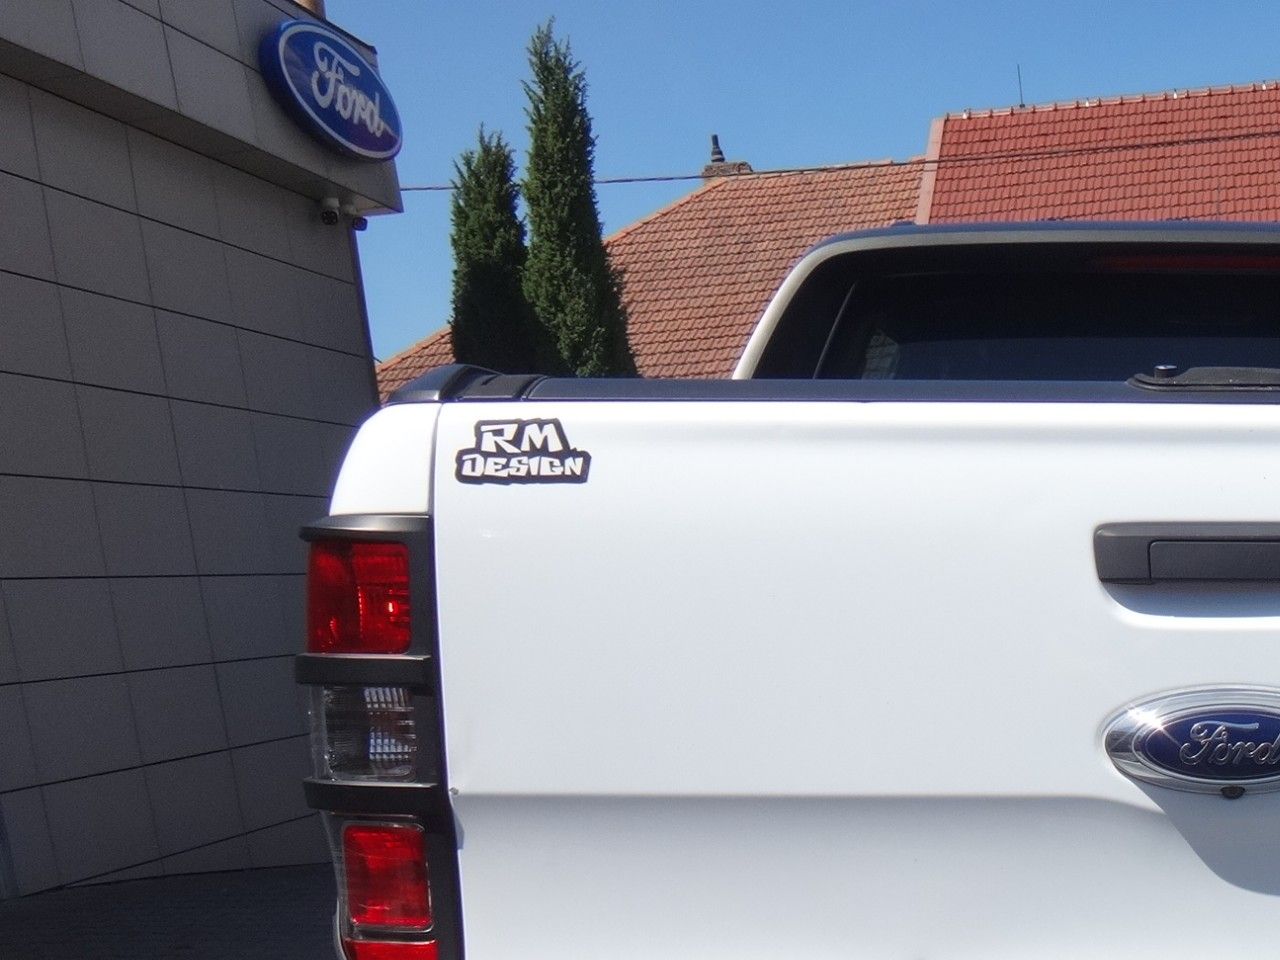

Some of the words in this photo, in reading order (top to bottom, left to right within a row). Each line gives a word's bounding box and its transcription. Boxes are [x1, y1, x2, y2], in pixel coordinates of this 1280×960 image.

[311, 41, 388, 138] Ford
[480, 423, 563, 454] RM
[461, 453, 584, 478] DESIGN
